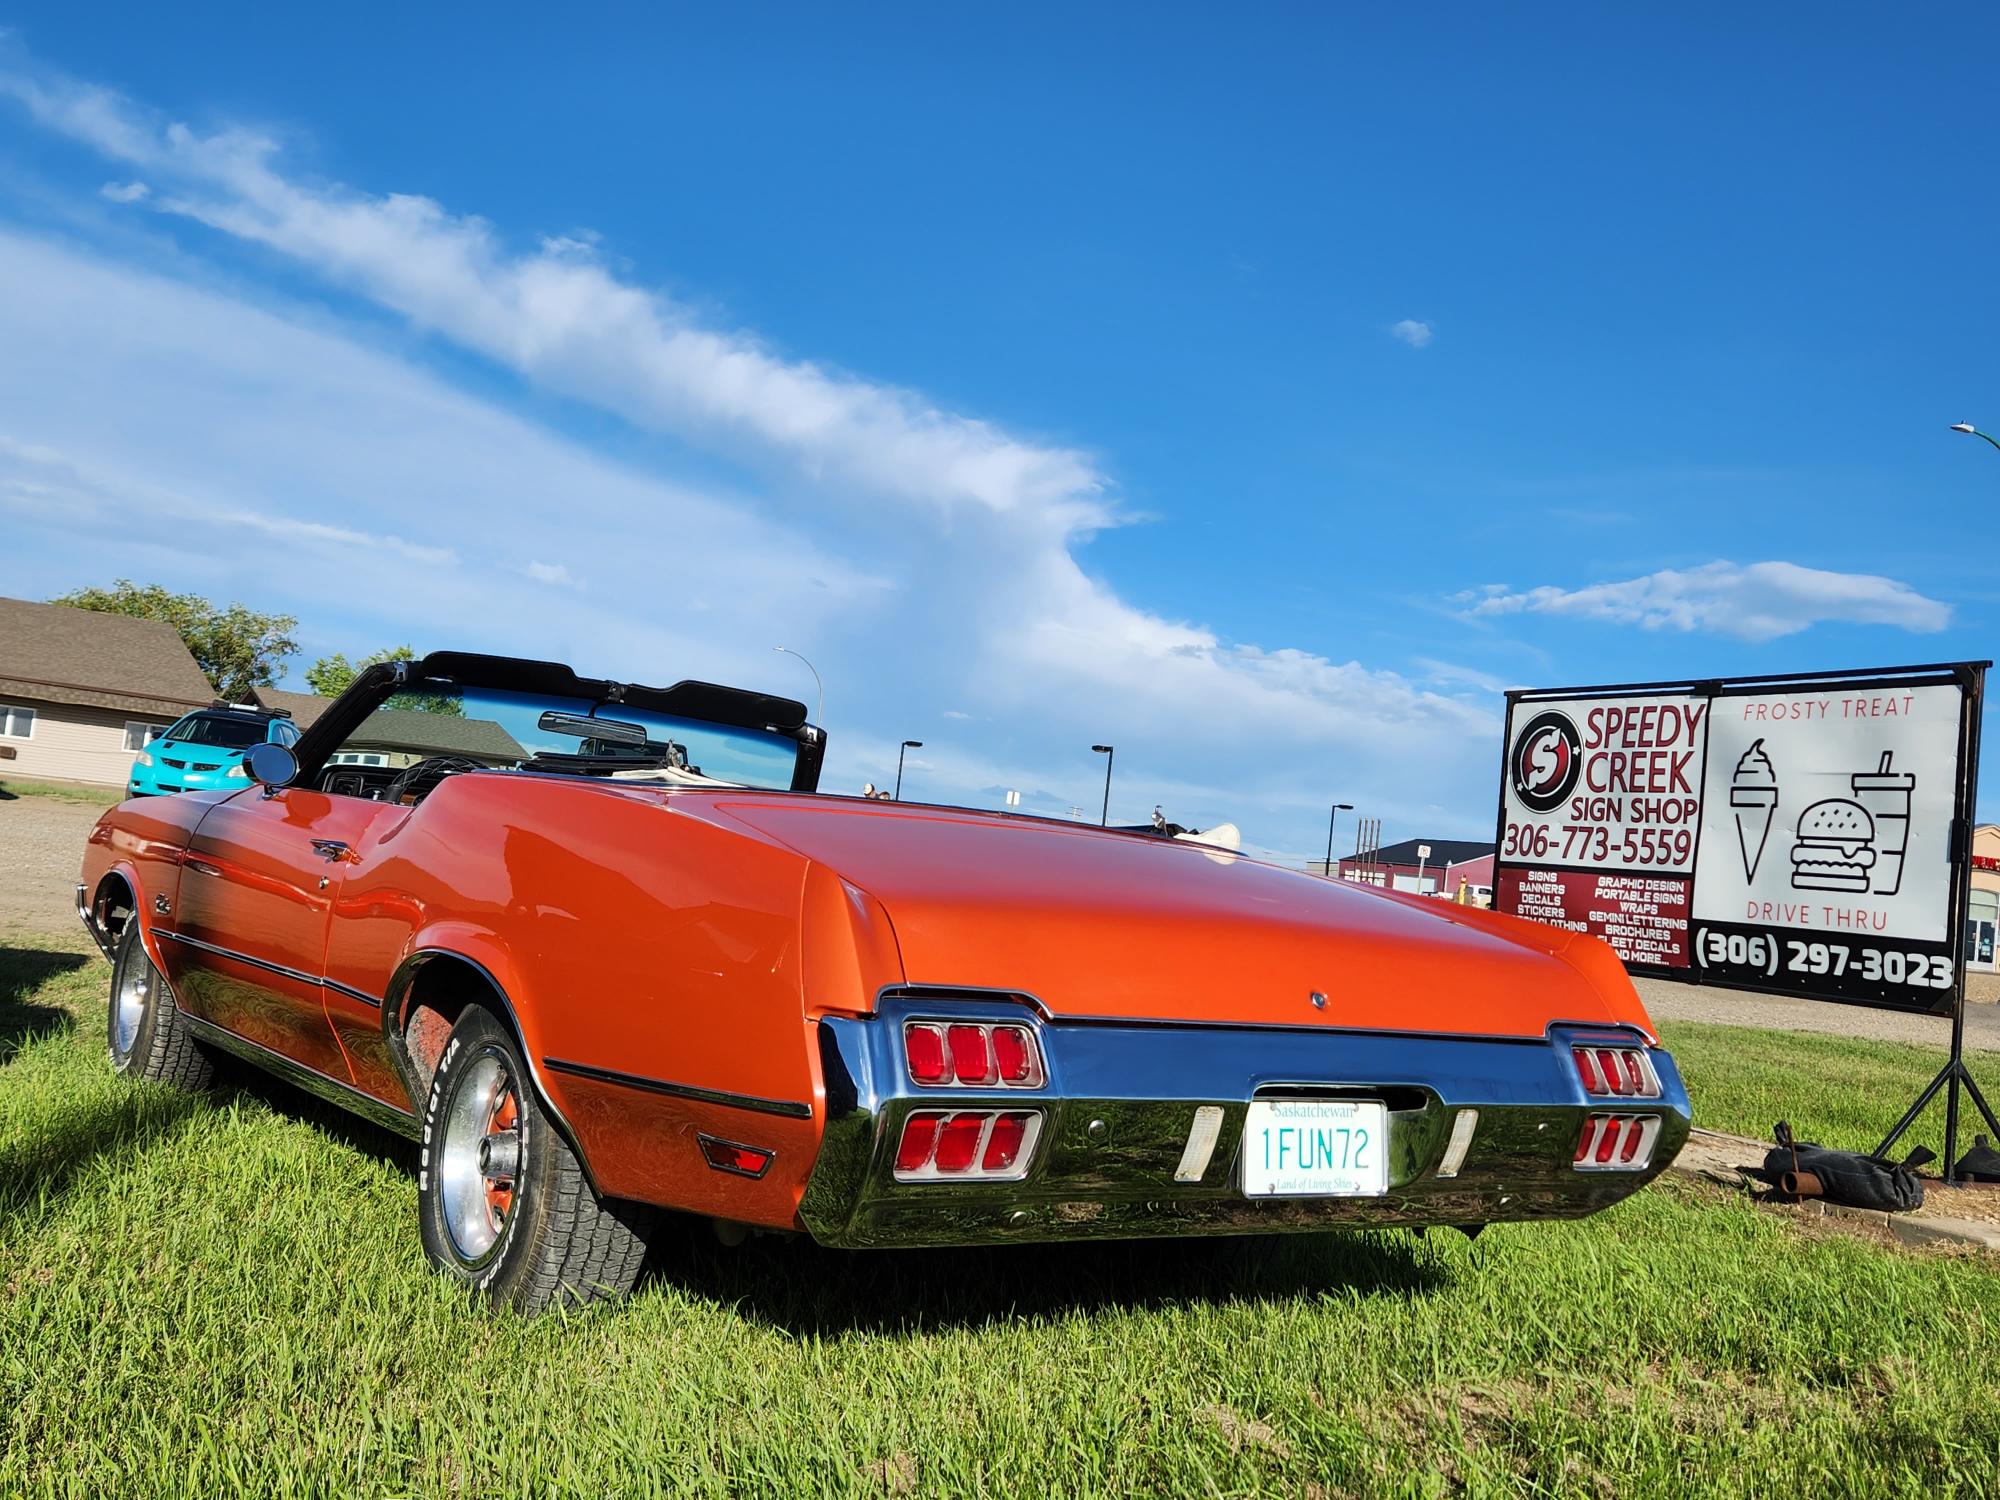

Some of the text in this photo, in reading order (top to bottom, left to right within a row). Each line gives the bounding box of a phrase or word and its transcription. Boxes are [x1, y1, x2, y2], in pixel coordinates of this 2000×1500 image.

[1744, 697, 1914, 721] FROSTY TREAT
[1585, 704, 1706, 749] SPEEDY
[1586, 751, 1695, 793] CREEK
[1571, 797, 1698, 824] SIGN SHOP
[1504, 823, 1692, 865] 306-773-5559
[1528, 871, 1557, 883] SIGNS
[1598, 877, 1684, 892] GRAPHIC DESIGN
[1519, 882, 1565, 895] BANNERS
[1595, 888, 1684, 905] PORTABLE SIGNS
[1522, 893, 1561, 906] DECALS
[1517, 904, 1565, 918] STICKERS
[1620, 902, 1658, 915] WRAPS
[1747, 901, 1887, 931] DRIVE THRU
[1589, 911, 1687, 930] GEMINI LETTERING
[1605, 924, 1671, 940] BROCHURES
[1636, 939, 1680, 954] DECALS
[1696, 927, 1953, 989] (306) 297-3023
[420, 1037, 460, 1191] Radial T/A
[1274, 1102, 1353, 1118] Saskatchewan
[1263, 1128, 1369, 1170] 1FUN72
[1277, 1178, 1297, 1190] Land
